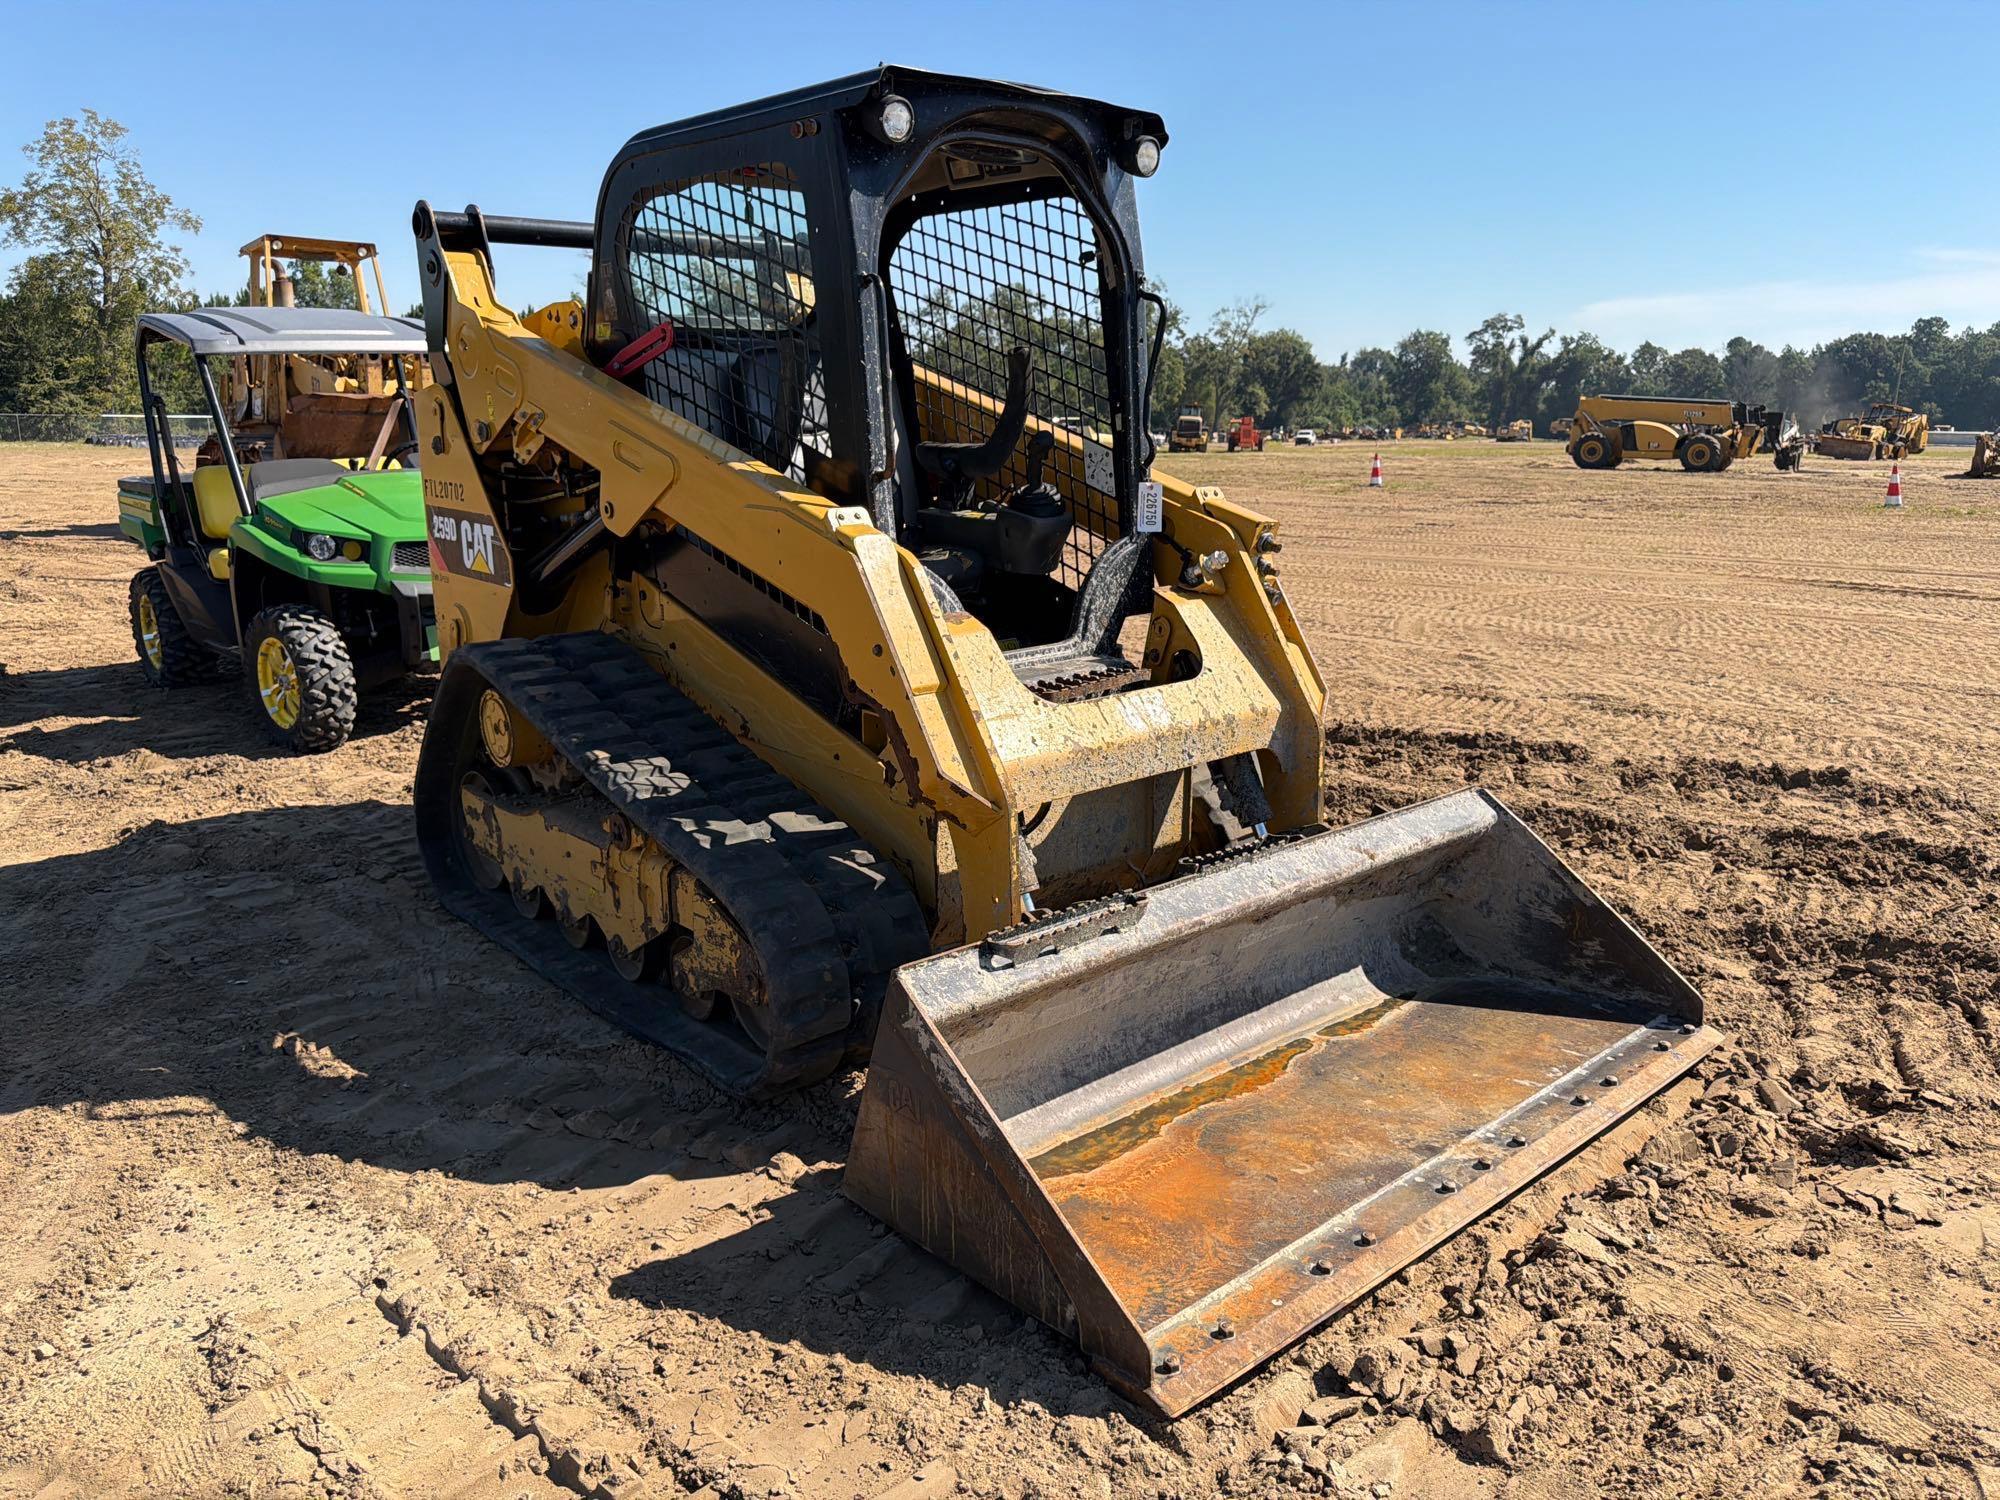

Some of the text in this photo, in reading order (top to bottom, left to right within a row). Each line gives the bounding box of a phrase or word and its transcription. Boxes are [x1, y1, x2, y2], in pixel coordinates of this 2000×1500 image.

[424, 479, 465, 502] FTL20702
[1145, 492, 1158, 526] 226750
[432, 514, 457, 541] 259D
[460, 519, 495, 575] CAT
